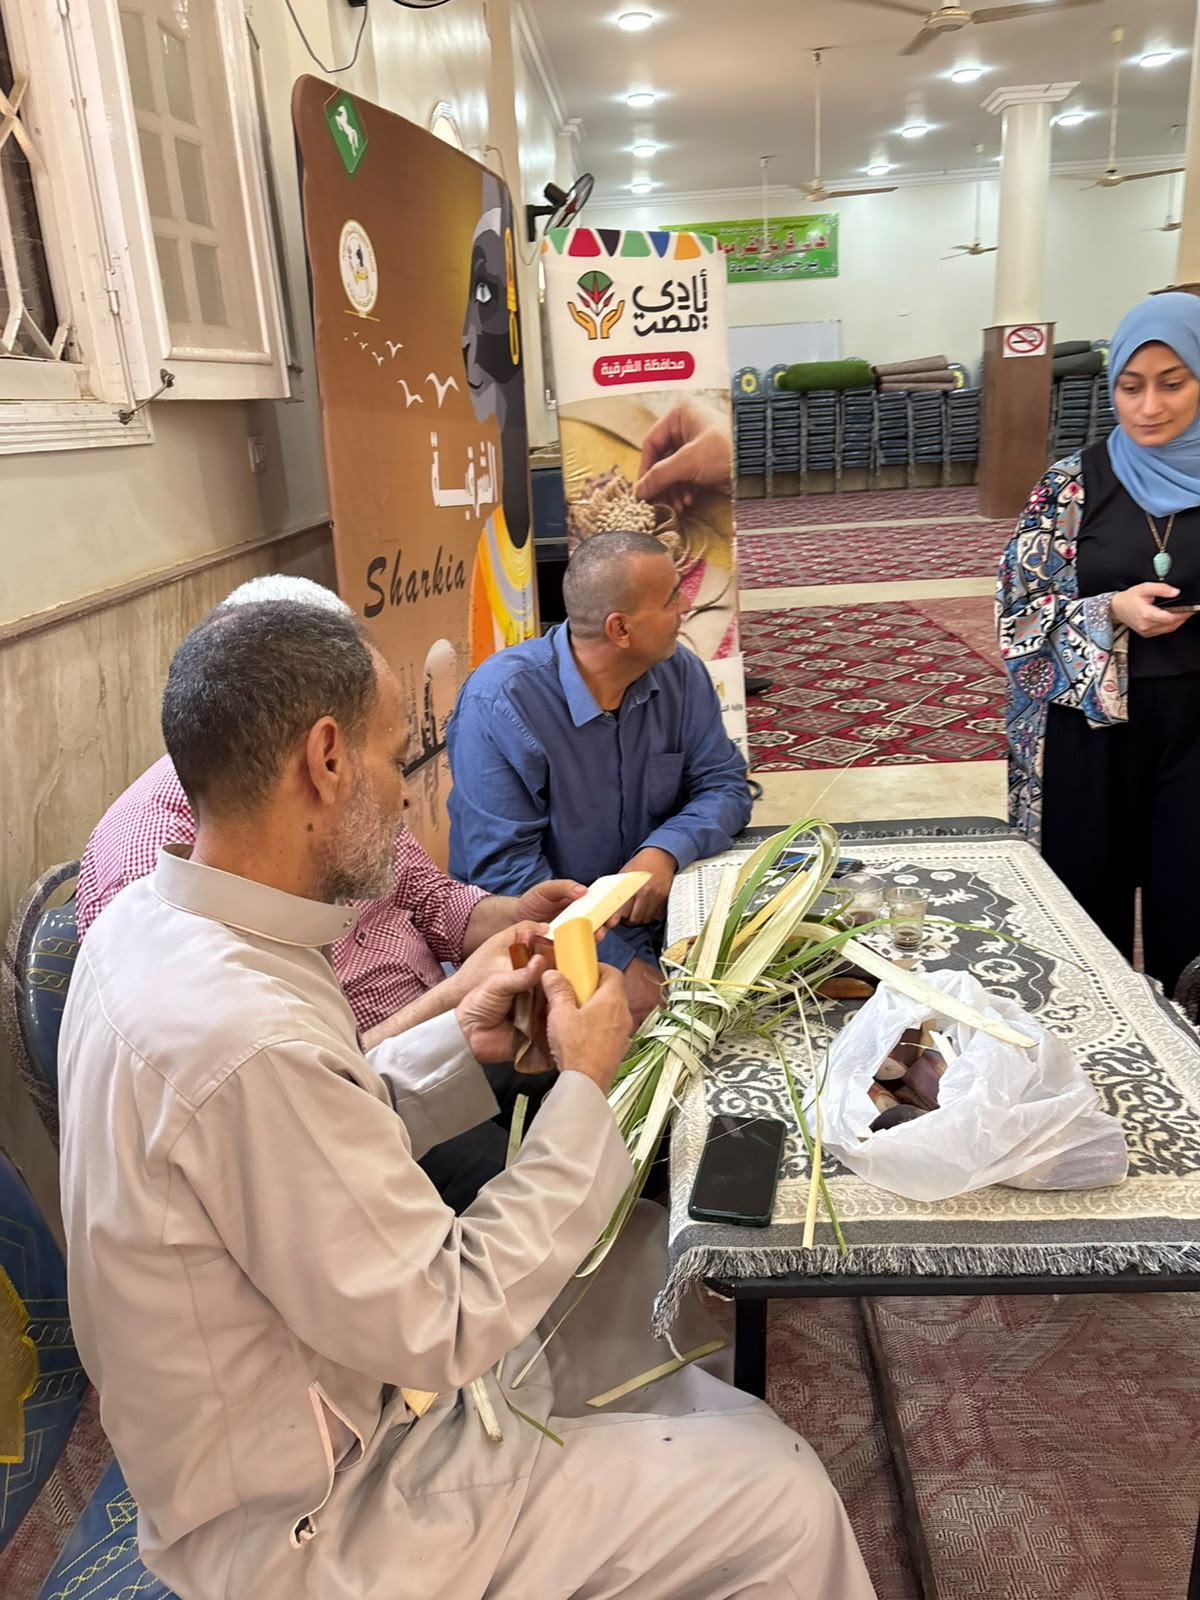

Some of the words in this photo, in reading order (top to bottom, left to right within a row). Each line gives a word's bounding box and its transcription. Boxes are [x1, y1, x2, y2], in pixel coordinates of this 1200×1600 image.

[600, 359, 642, 378] الشرقية
[644, 358, 686, 371] محافظة
[430, 431, 498, 521] الشرقية
[365, 546, 466, 618] Sharkia
